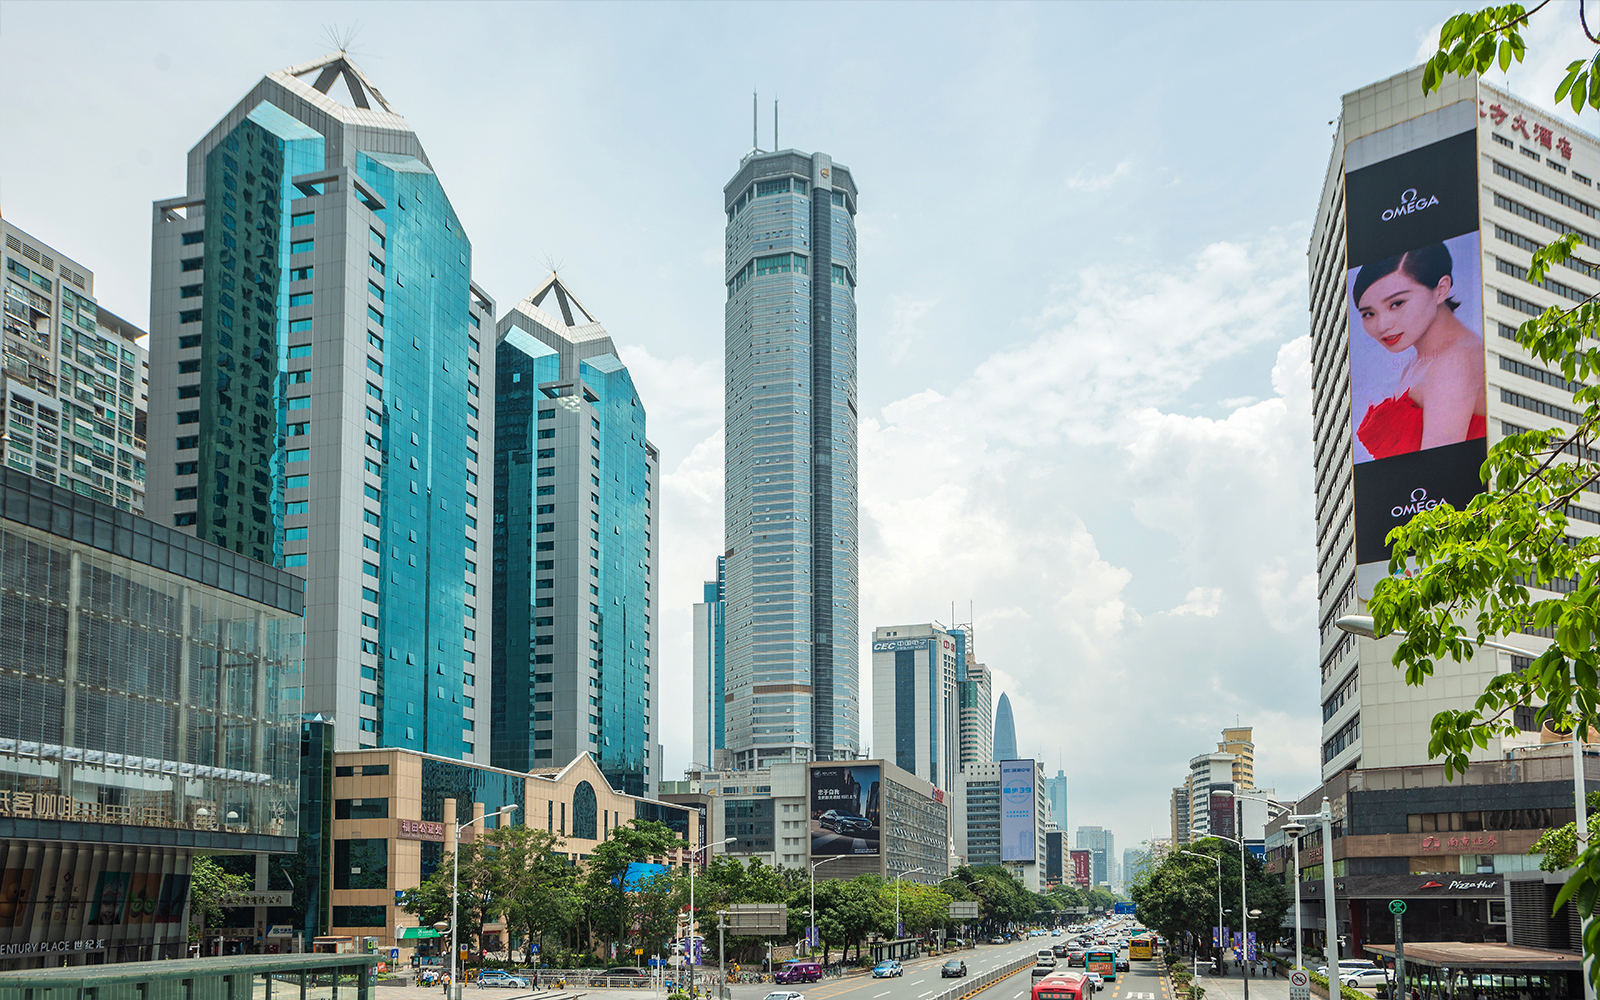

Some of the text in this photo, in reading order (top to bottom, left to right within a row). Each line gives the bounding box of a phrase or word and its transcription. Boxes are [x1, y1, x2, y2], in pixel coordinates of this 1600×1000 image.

[1381, 194, 1440, 222] OMEGA
[874, 642, 896, 651] CEC
[1222, 809, 1232, 836] 二手车
[1447, 834, 1498, 847] 南京证券
[1448, 880, 1498, 890] Pizza Hut
[40, 941, 70, 952] PLACE
[74, 939, 105, 951] 世纪汇
